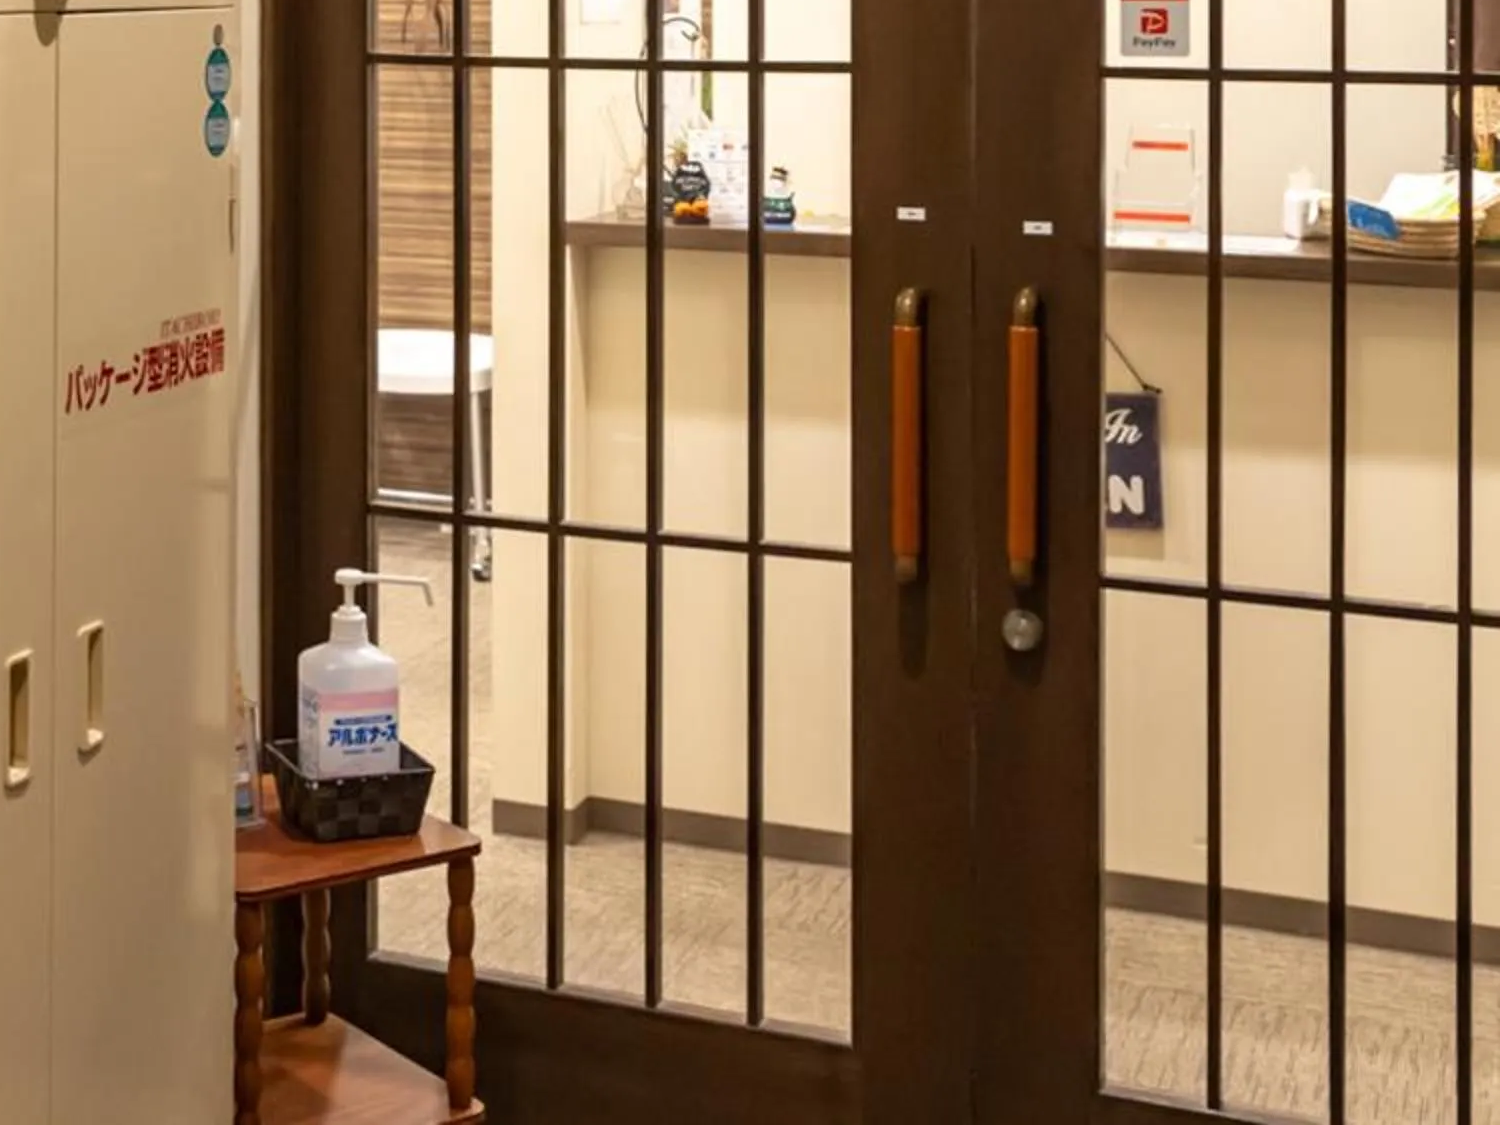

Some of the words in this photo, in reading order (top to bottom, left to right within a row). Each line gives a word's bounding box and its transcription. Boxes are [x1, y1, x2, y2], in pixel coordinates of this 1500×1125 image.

[1133, 35, 1176, 51] PayPay
[64, 326, 226, 415] パッケージ型消火設備
